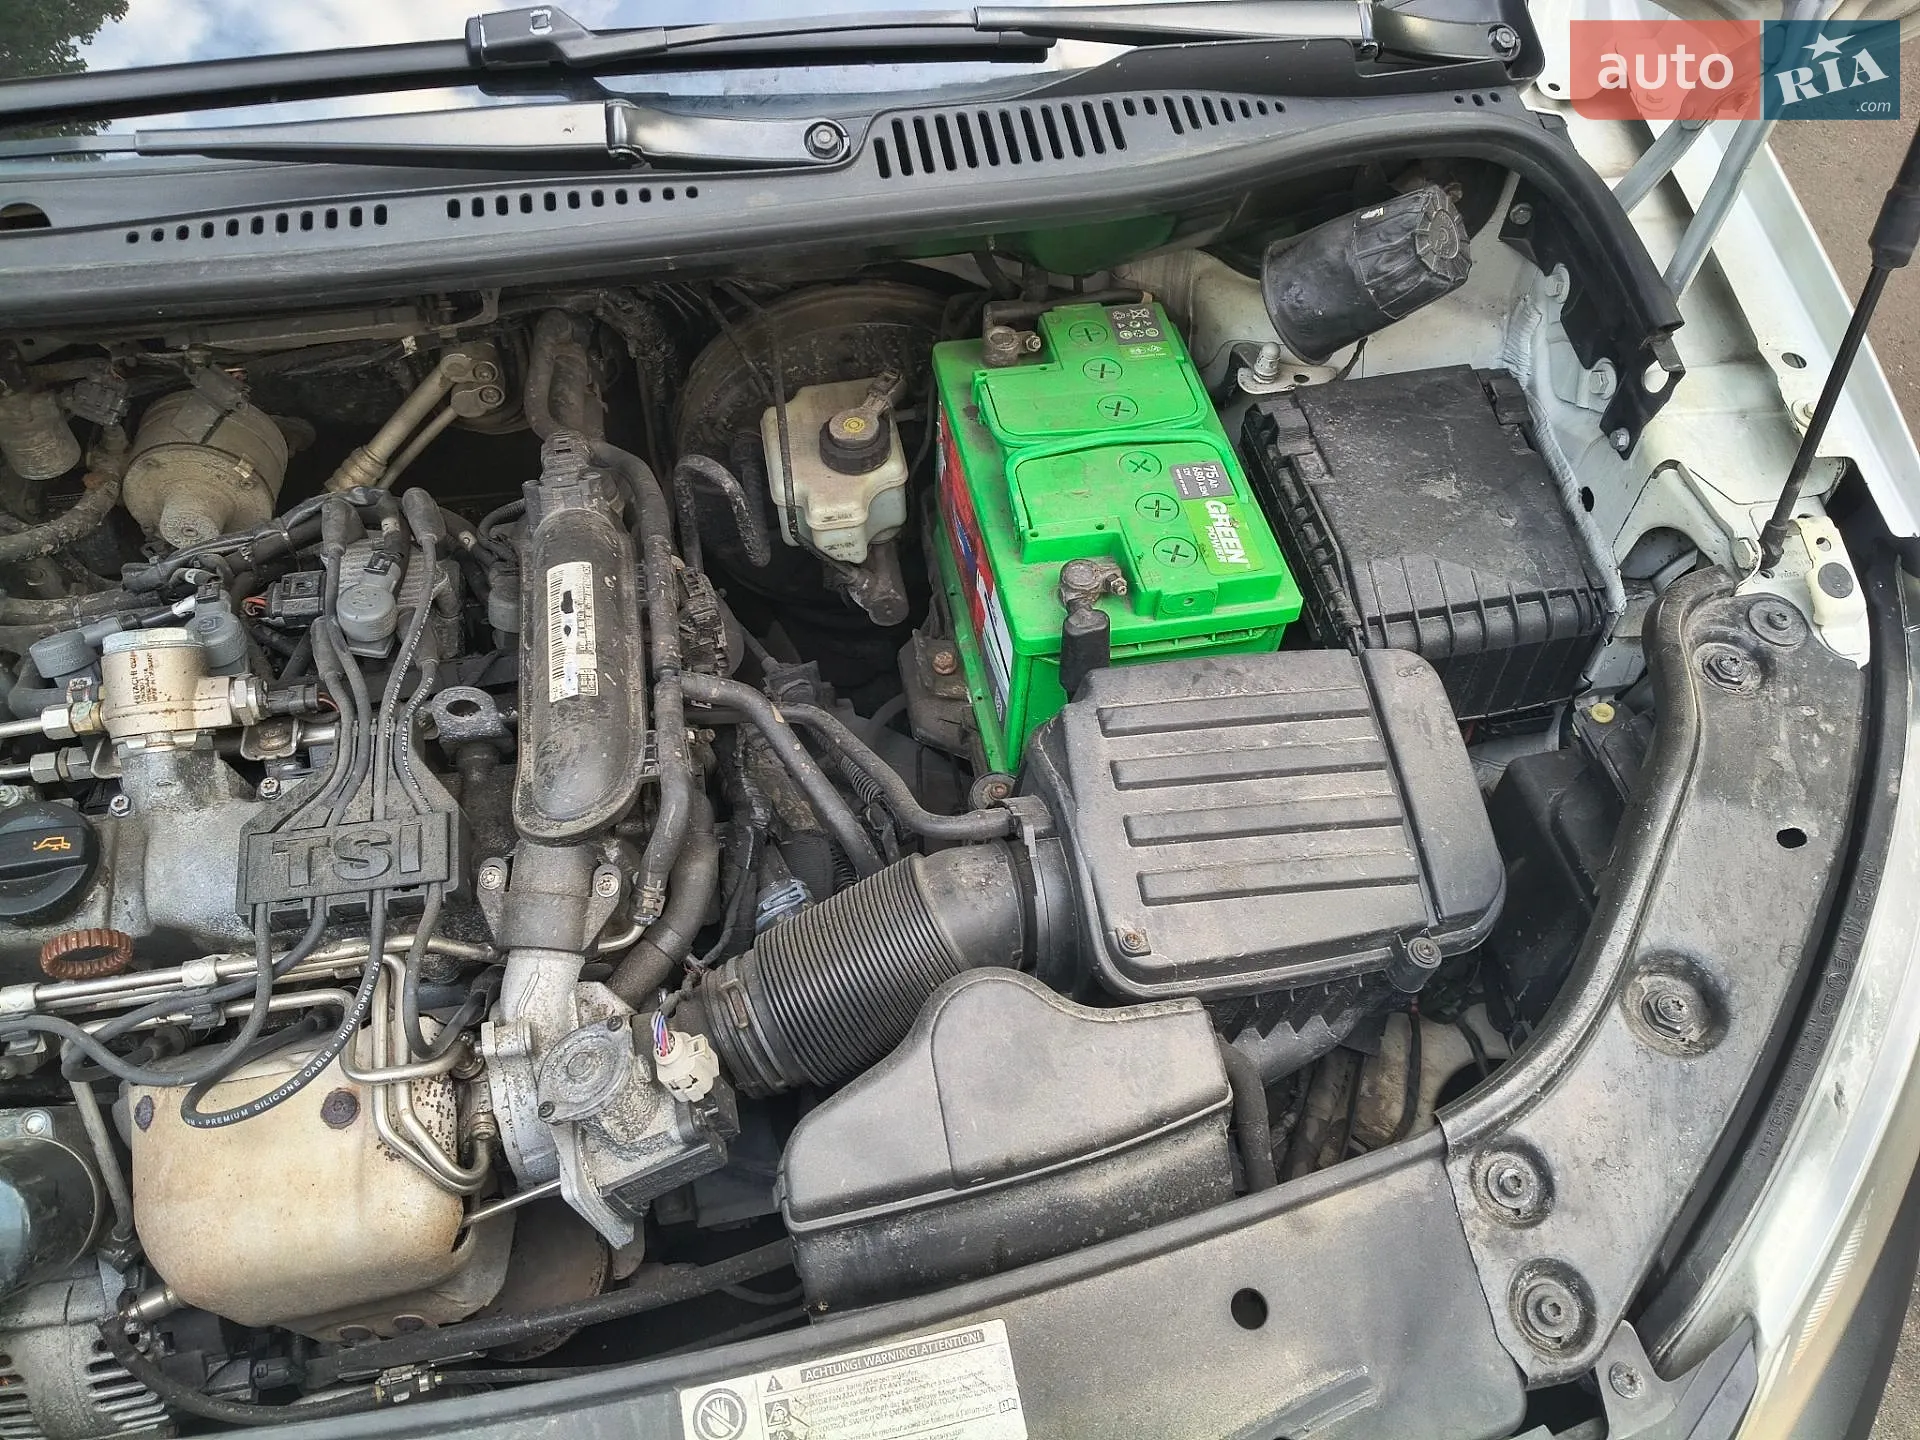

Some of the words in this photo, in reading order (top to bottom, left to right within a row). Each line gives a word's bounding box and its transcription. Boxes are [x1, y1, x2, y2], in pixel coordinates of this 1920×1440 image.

[1203, 464, 1220, 478] 75
[1204, 500, 1249, 564] GREEN
[270, 823, 423, 888] TSI
[205, 1108, 249, 1126] PREMIUM
[254, 1080, 301, 1111] SILICONE
[304, 1050, 332, 1077] CABLE
[338, 1017, 357, 1040] HIGH
[354, 984, 373, 1016] POWER
[805, 1359, 862, 1381] ACHTUNG!
[864, 1345, 919, 1368] WARNING!
[920, 1334, 982, 1355] ATTENTION!
